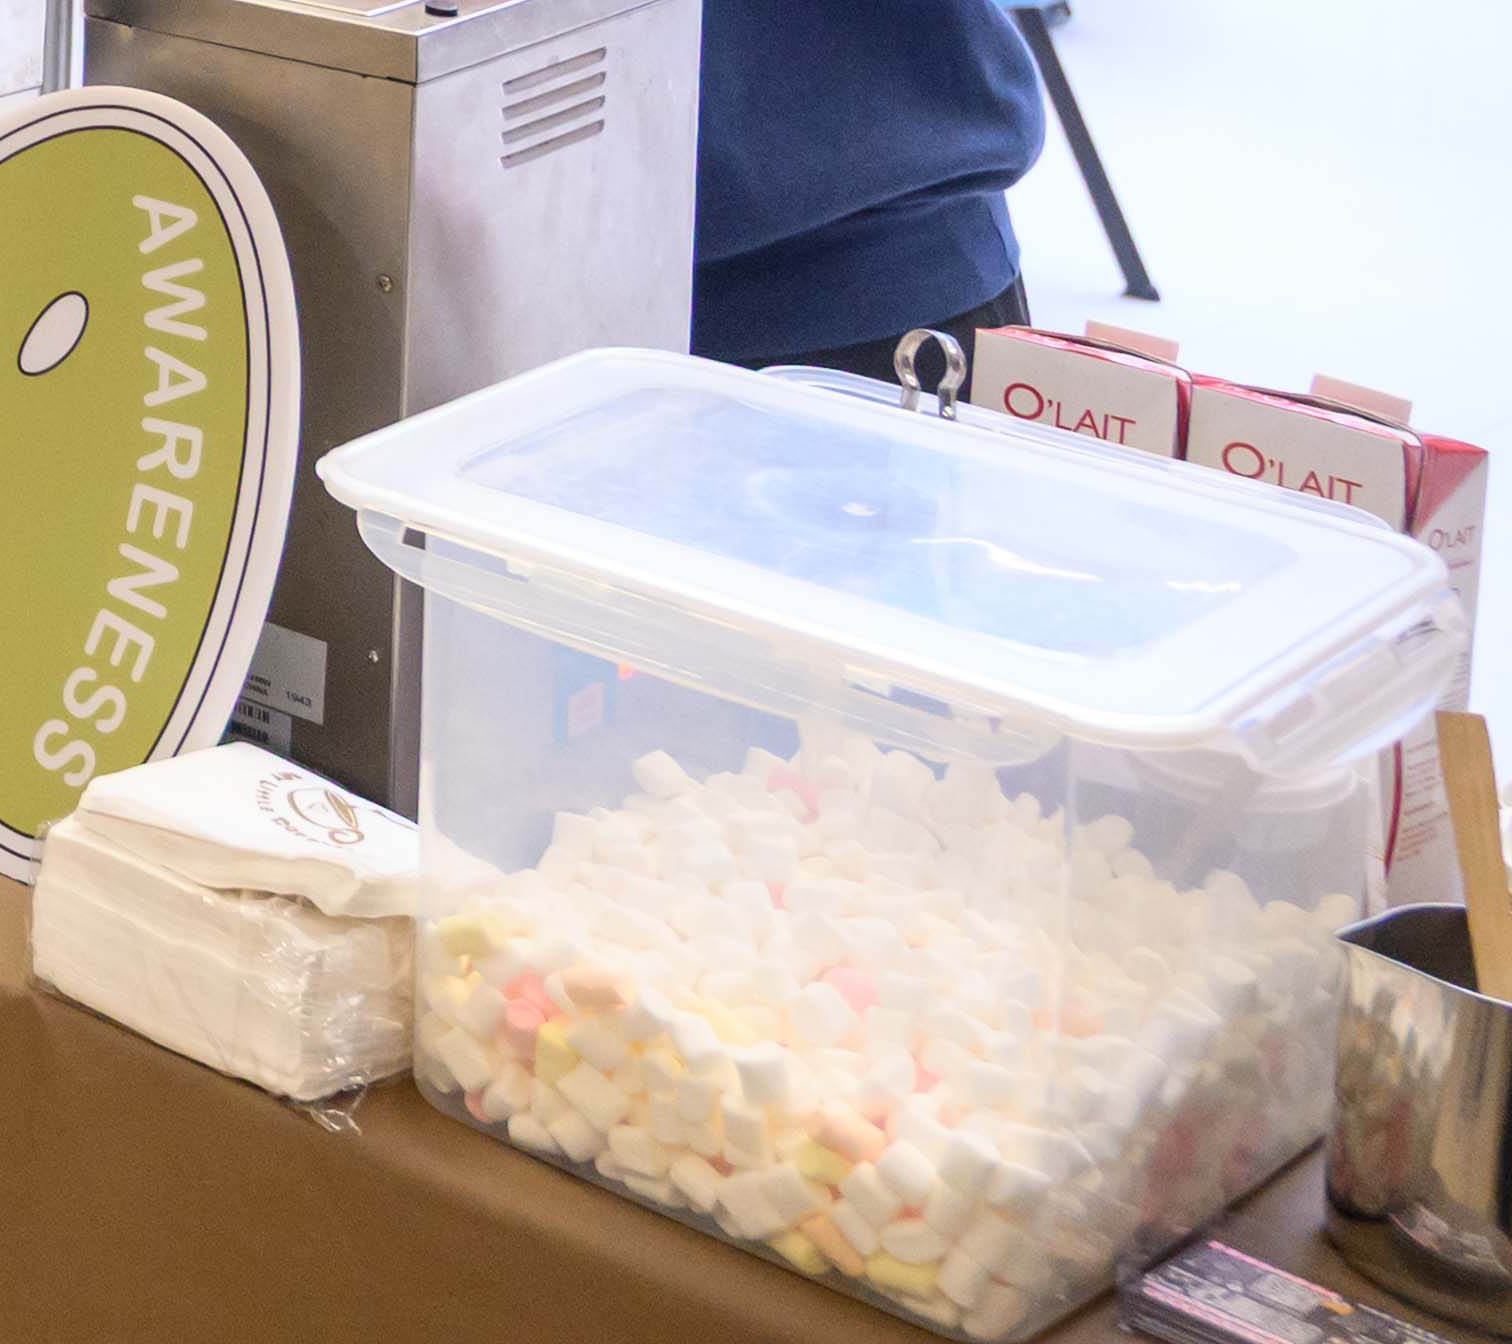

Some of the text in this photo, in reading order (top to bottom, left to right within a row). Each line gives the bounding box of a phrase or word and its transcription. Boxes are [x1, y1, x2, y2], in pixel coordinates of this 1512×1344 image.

[1002, 382, 1137, 447] O'LAIT
[32, 194, 209, 789] AWARENESS
[1221, 442, 1363, 506] O'LAIT
